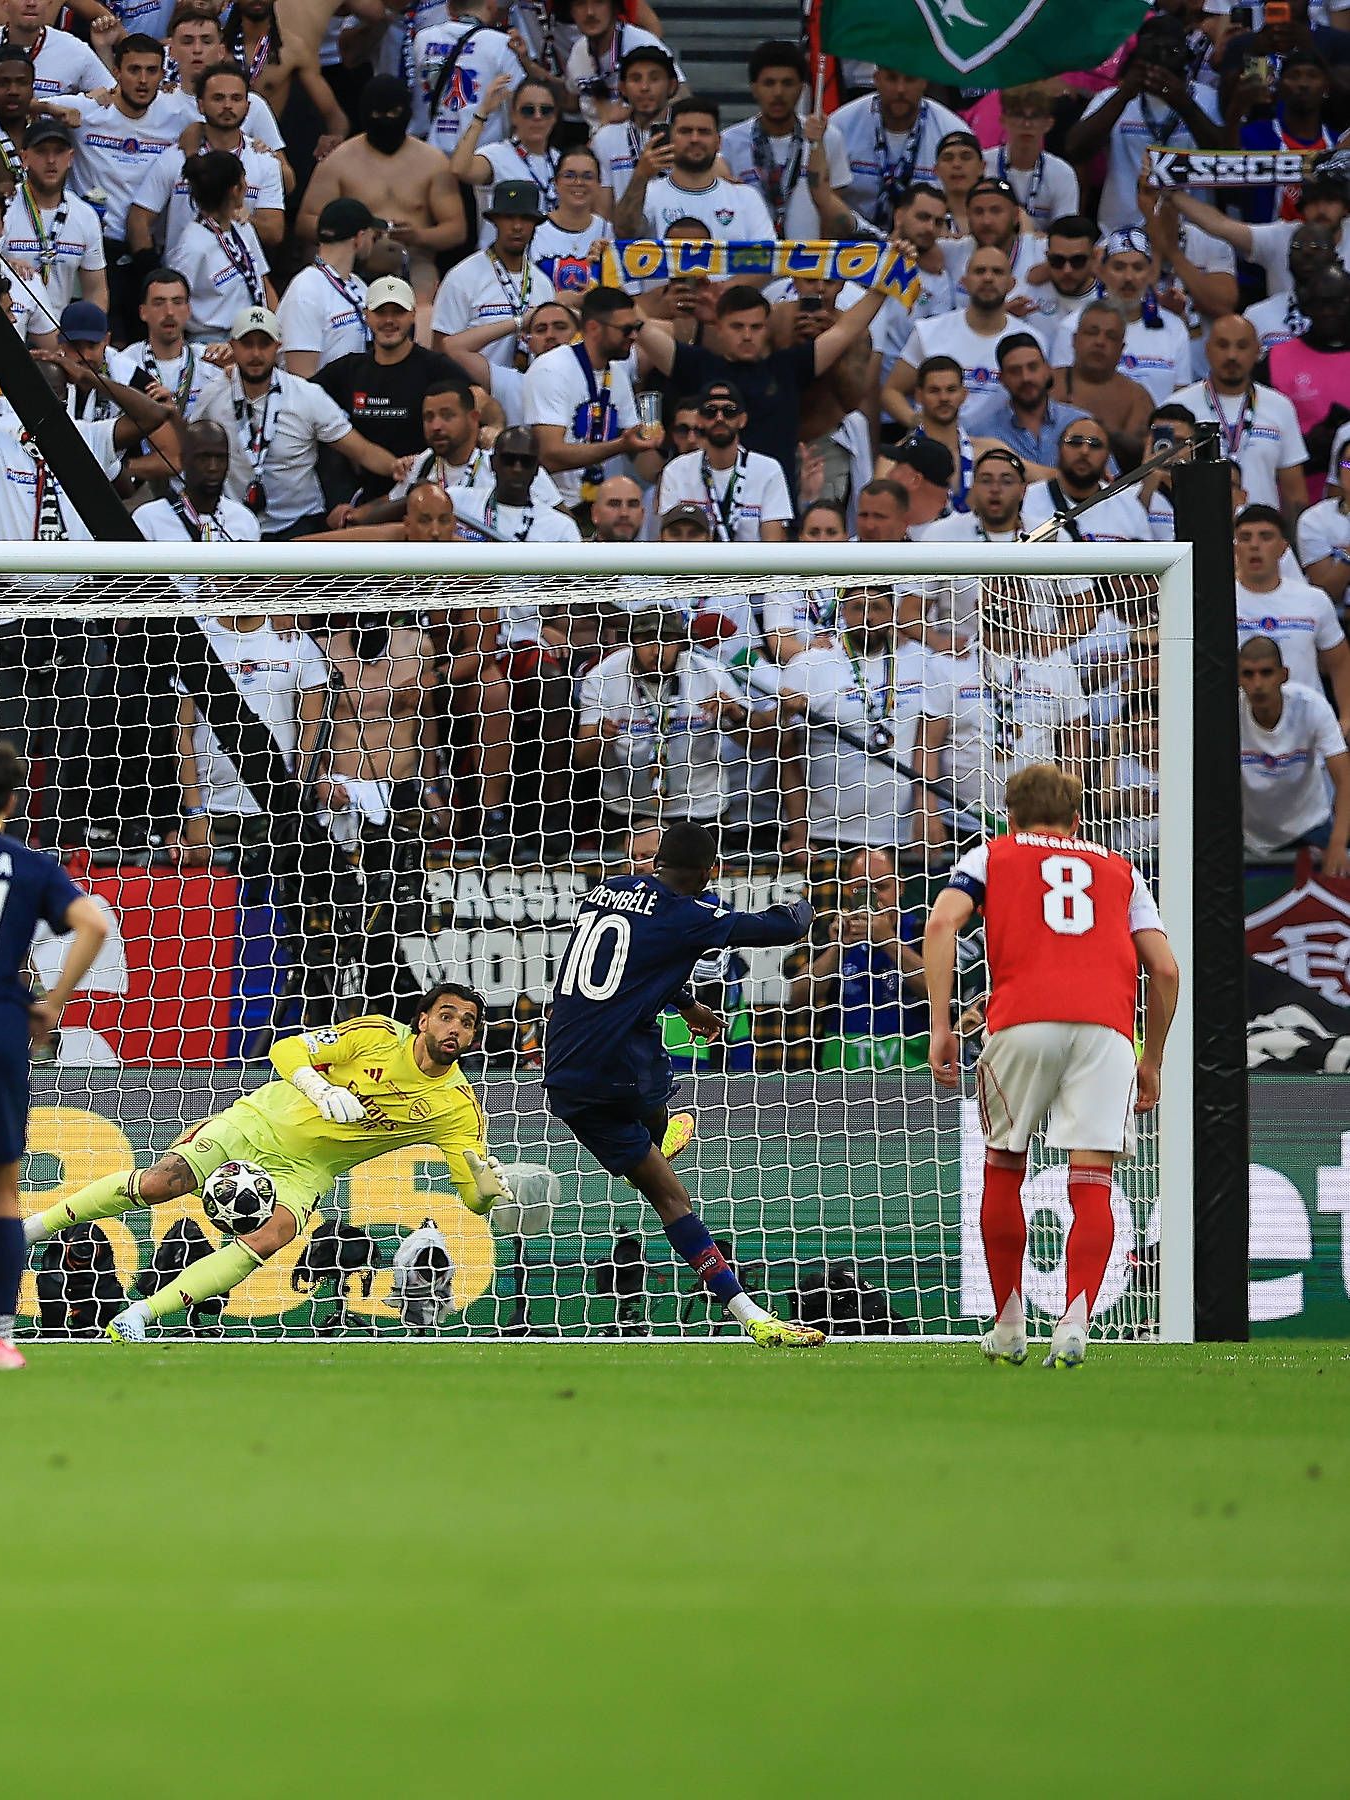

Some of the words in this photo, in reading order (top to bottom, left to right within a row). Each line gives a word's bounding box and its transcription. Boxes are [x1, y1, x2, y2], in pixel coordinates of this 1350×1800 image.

[586, 887, 658, 916] .DEMBÉLÉ
[1040, 855, 1095, 936] 8
[560, 909, 631, 1001] 10
[855, 1039, 900, 1068] TV
[347, 1079, 399, 1133] Eirates
